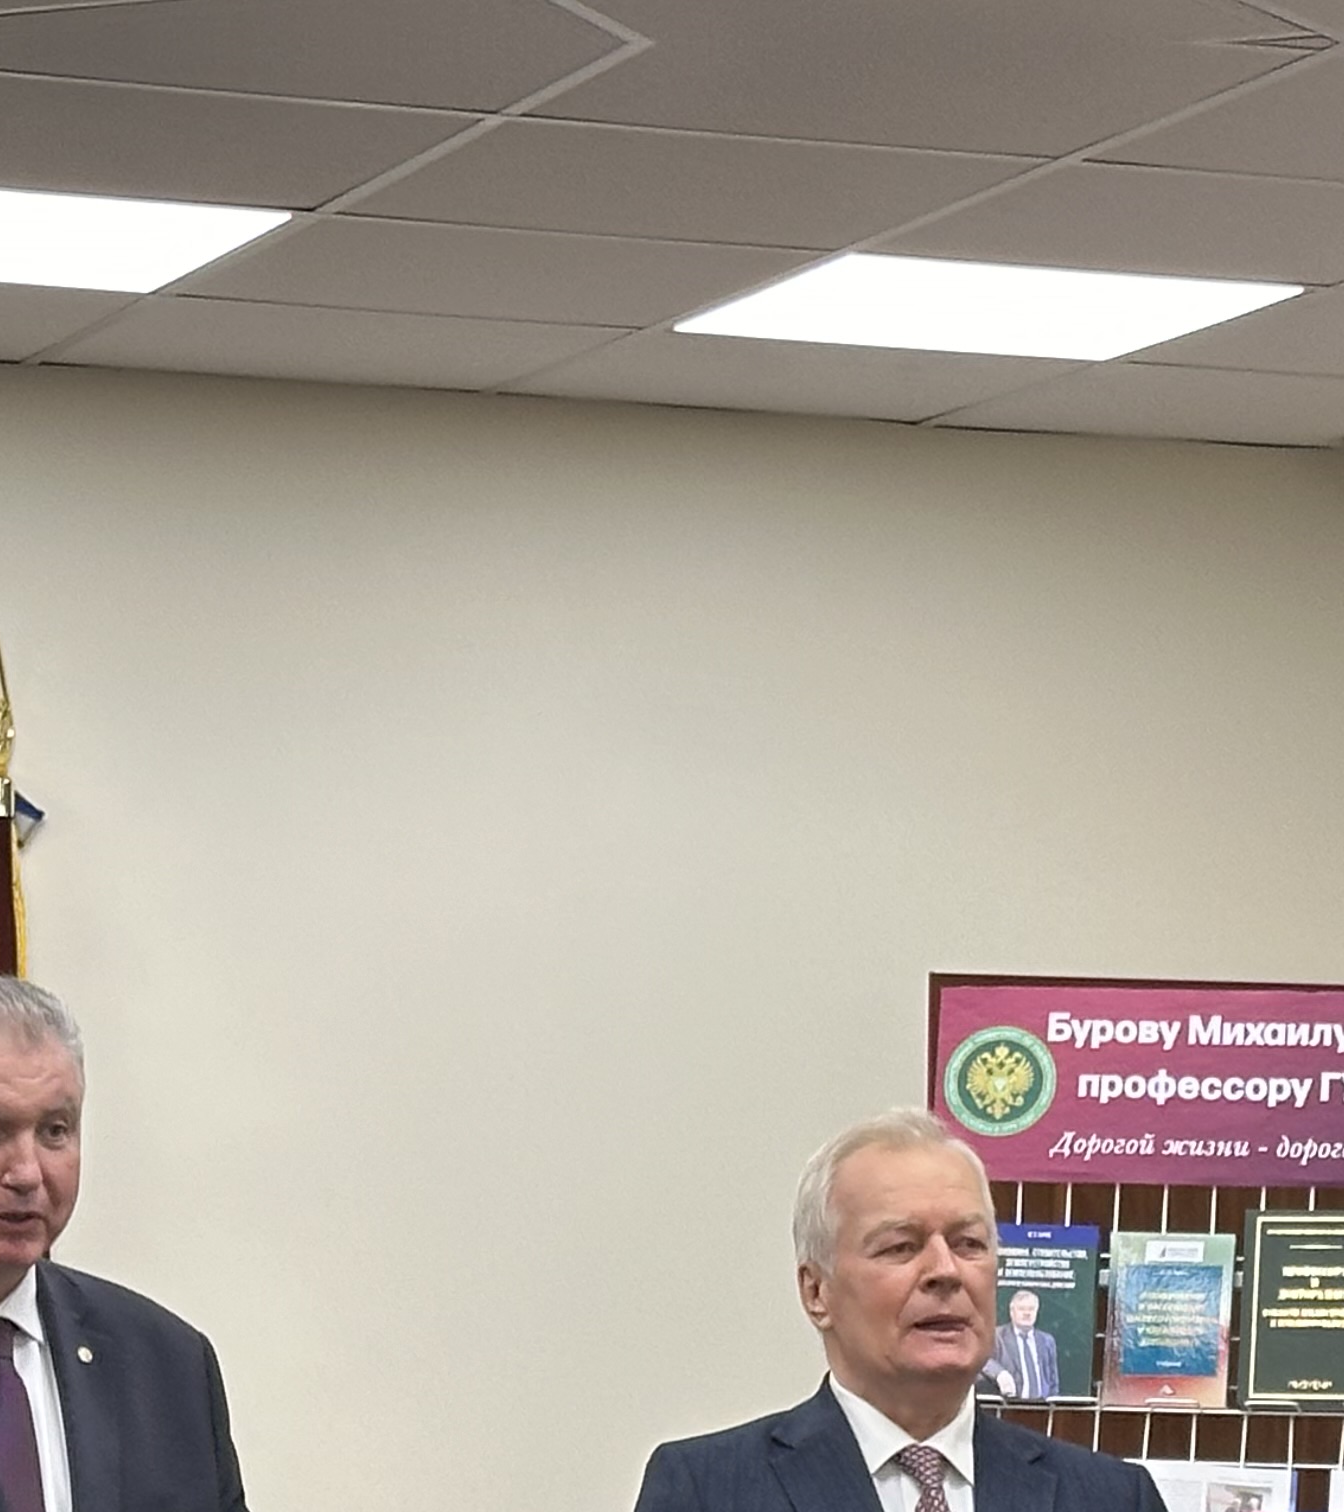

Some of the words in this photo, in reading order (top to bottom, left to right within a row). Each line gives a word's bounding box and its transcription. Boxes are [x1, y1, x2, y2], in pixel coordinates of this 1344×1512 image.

[1047, 1011, 1181, 1050] Бурову
[1077, 1068, 1312, 1108] профессору
[1049, 1131, 1156, 1161] Дорогой
[1161, 1138, 1250, 1157] жизни
